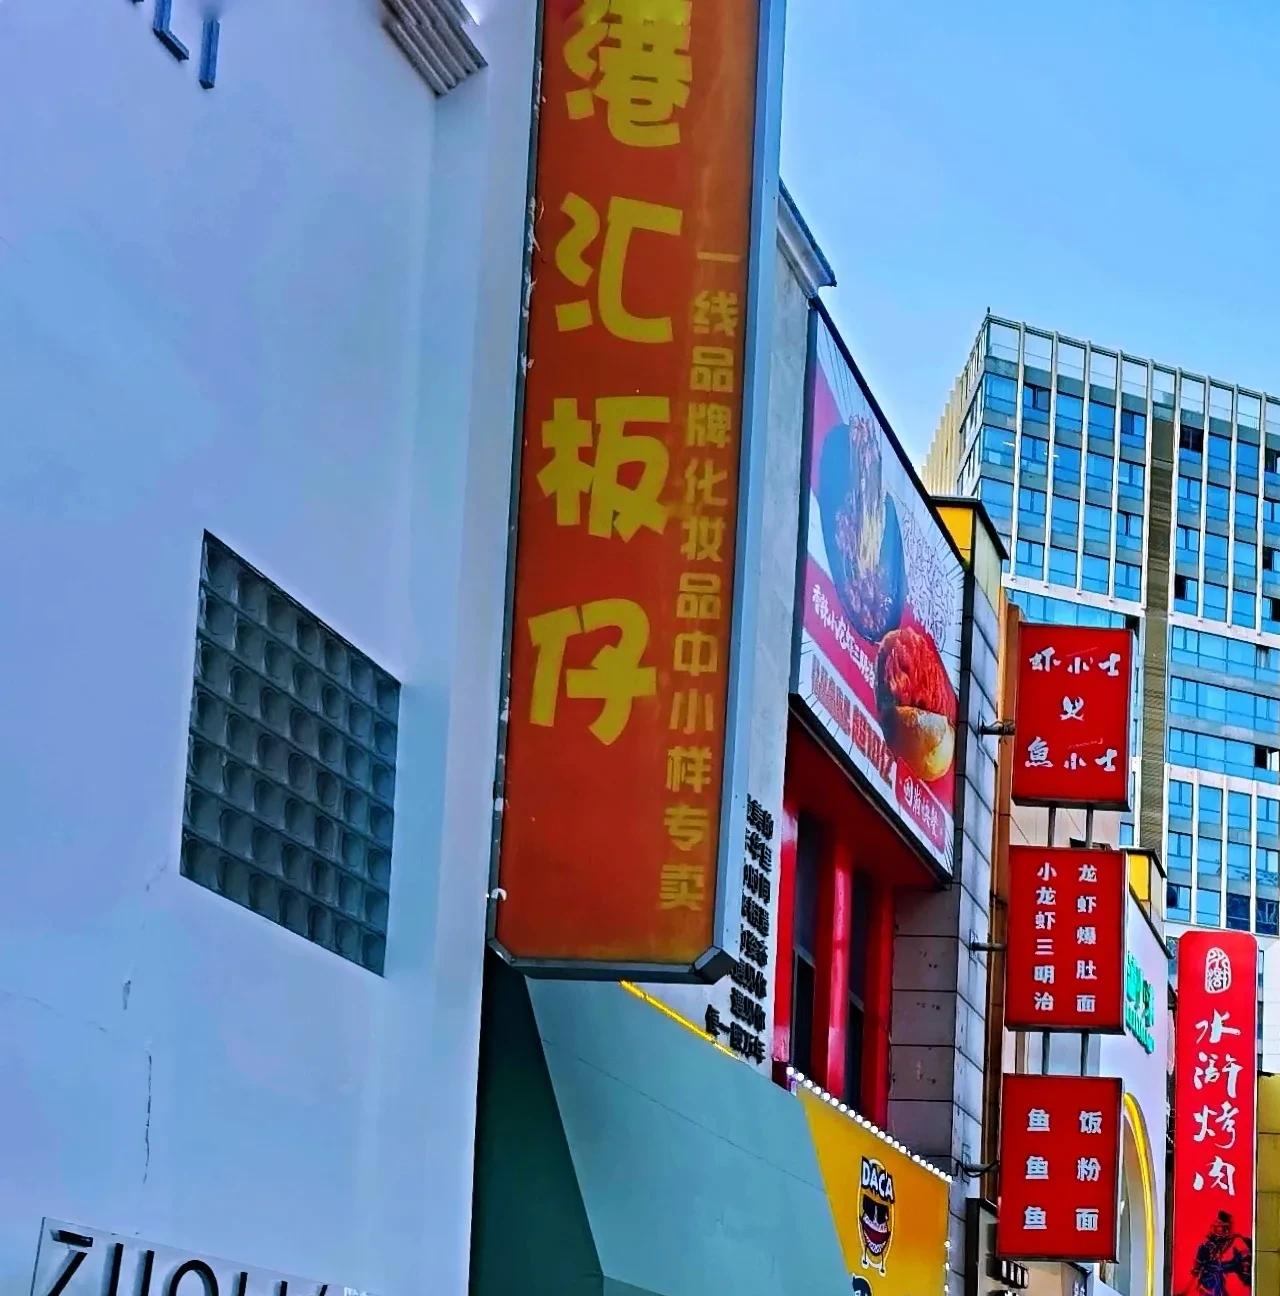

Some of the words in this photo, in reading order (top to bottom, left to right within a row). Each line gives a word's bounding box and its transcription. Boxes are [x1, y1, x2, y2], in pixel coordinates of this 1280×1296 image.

[527, 0, 694, 745] 港汇板仔
[659, 250, 741, 910] 一线品牌化妆品中小样专卖
[1034, 861, 1058, 1012] 小龙虾三明治
[1075, 862, 1098, 1014] 龙虾爆肚面
[860, 1155, 894, 1200] DACA
[1192, 1008, 1243, 1197] 水浒烤肉
